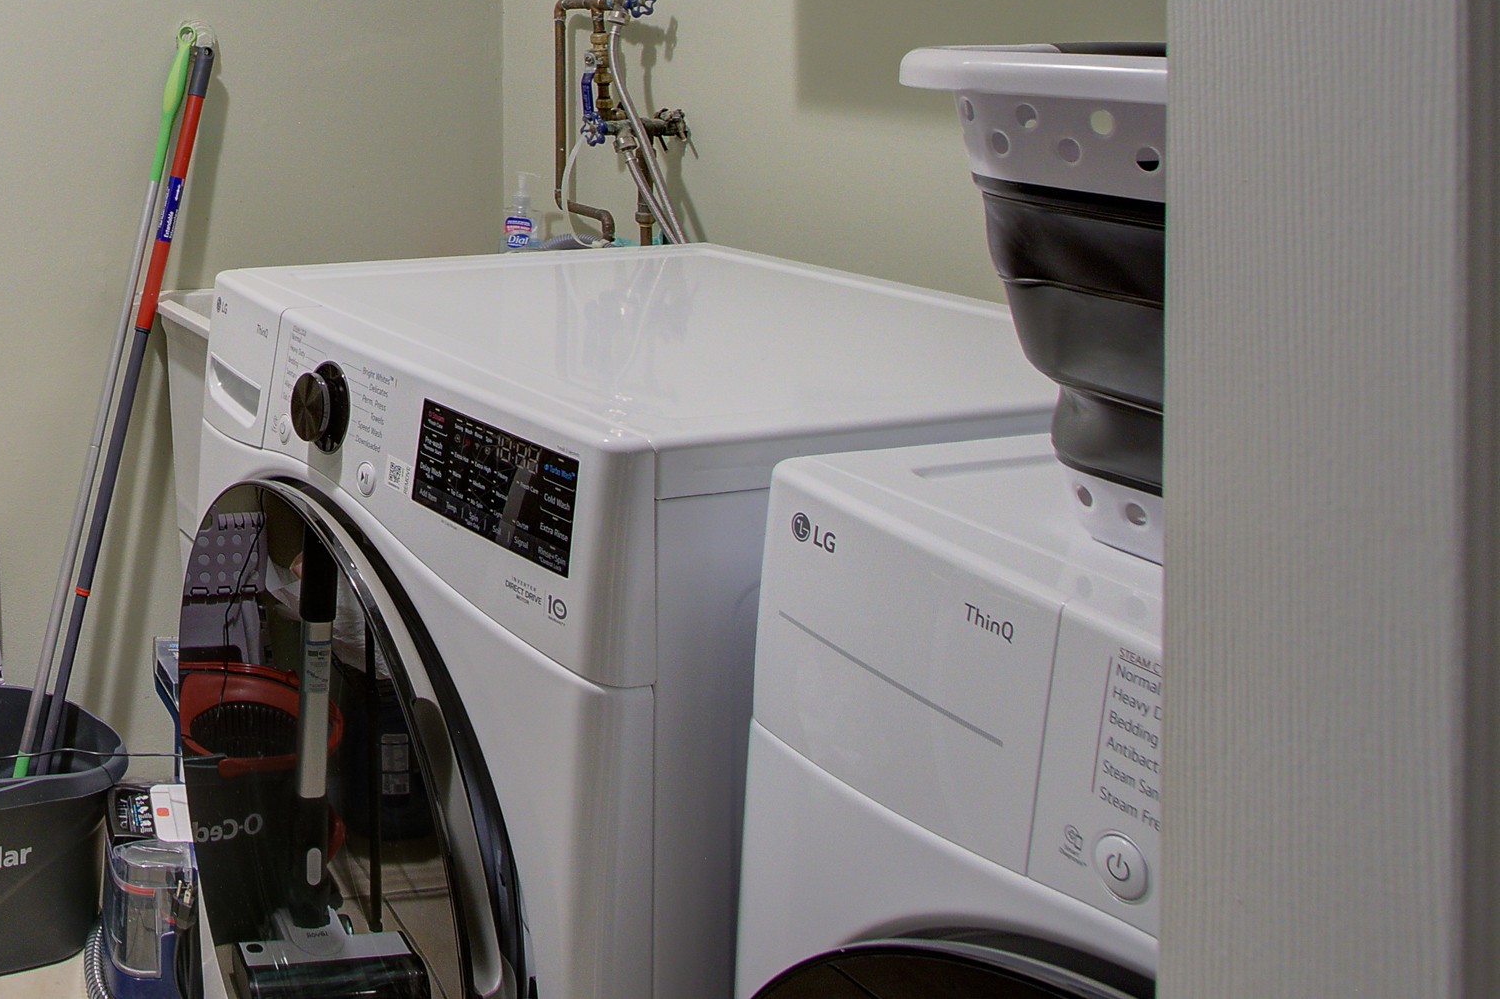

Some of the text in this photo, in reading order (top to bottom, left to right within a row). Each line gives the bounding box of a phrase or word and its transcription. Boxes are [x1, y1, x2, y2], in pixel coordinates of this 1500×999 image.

[508, 234, 529, 245] Dial
[221, 301, 228, 314] LG
[362, 366, 375, 379] Bright
[368, 383, 389, 398] Delicates
[374, 399, 387, 412] Press
[370, 412, 384, 426] Towels
[357, 420, 383, 439] Speed Wash
[355, 434, 381, 453] Downloaded
[403, 466, 411, 495] REMOVE
[543, 493, 570, 511] Cold Wash
[514, 535, 529, 549] Signal
[540, 522, 568, 542] Extra Rinse
[813, 525, 836, 553] LG
[505, 579, 542, 605] DIRECT DRIVE
[512, 576, 537, 592] INVERTER
[548, 594, 567, 620] 10
[964, 602, 1015, 644] ThinQ
[1120, 648, 1152, 668] STEAM
[1116, 663, 1161, 696] Normal
[1112, 686, 1149, 717] Heavy
[1109, 710, 1159, 749] Bedding
[1106, 736, 1160, 774] Antibact
[1103, 759, 1160, 801] Steam San
[1099, 786, 1160, 832] Steam Fre
